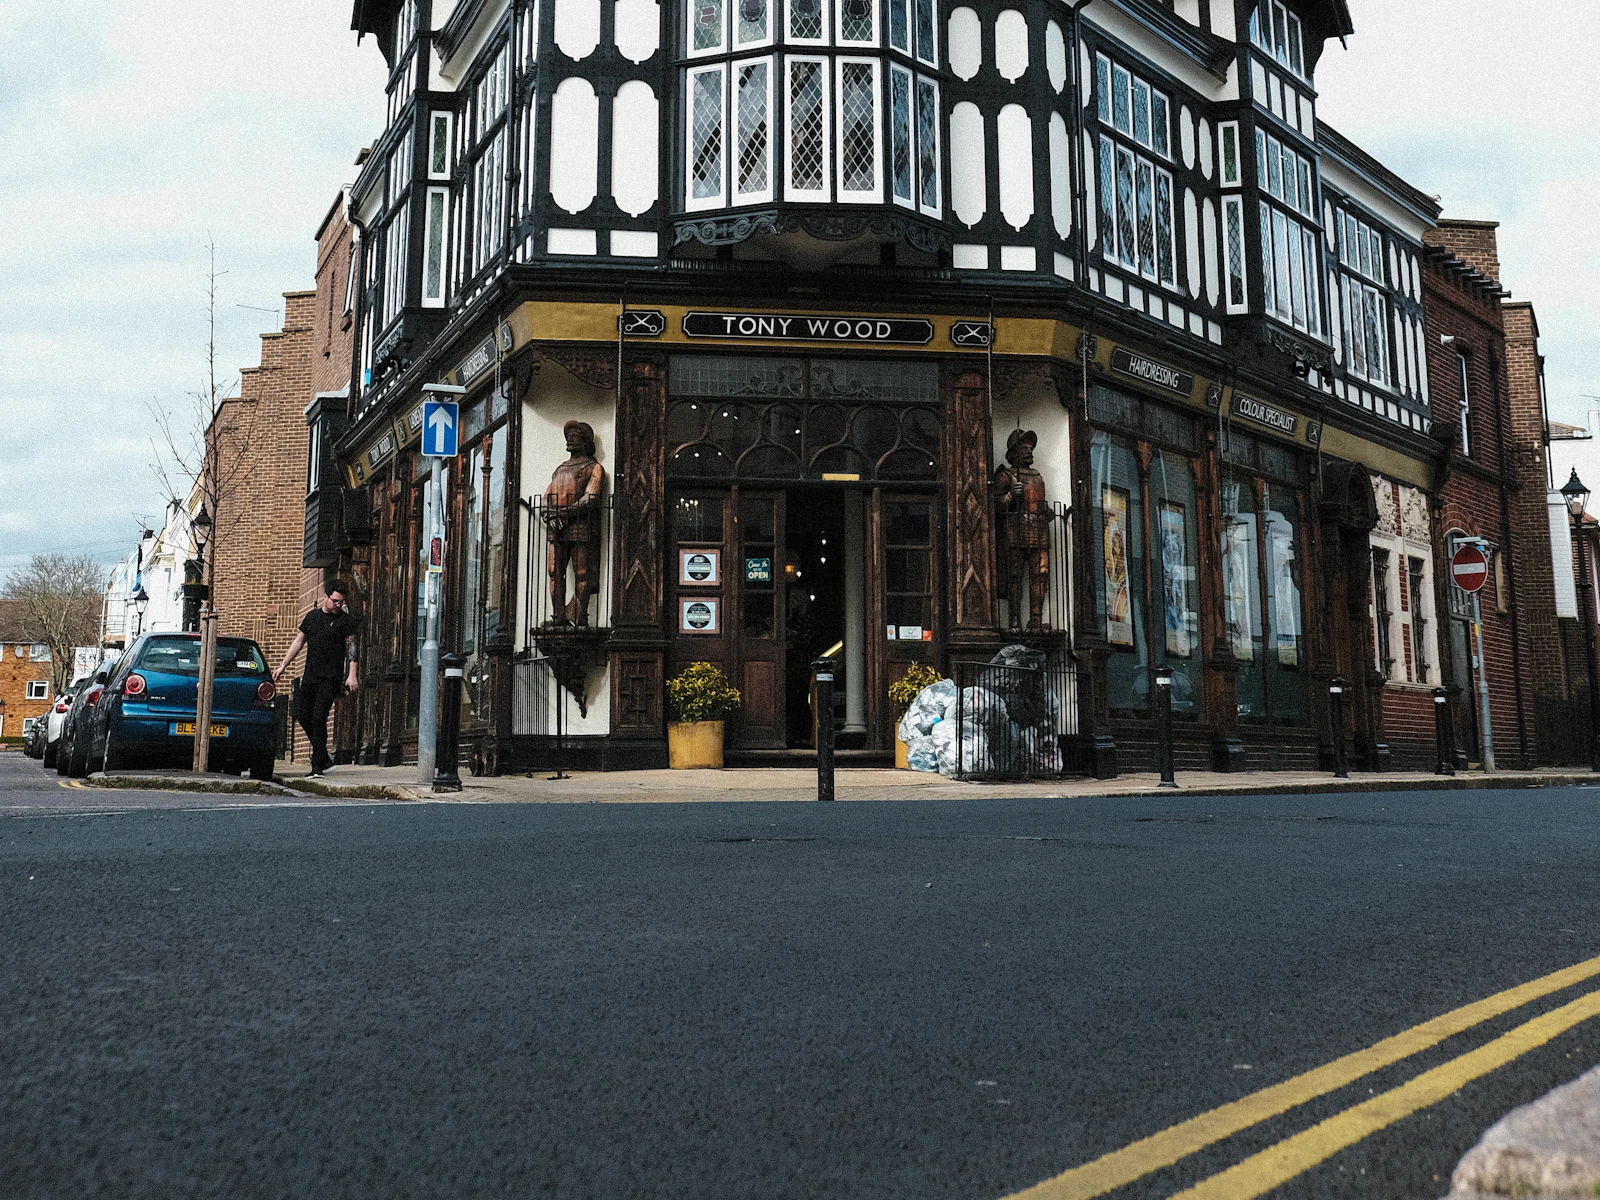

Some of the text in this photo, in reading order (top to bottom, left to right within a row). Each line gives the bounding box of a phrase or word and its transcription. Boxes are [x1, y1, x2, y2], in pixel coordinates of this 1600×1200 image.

[722, 316, 892, 339] TONY WOOD
[1128, 356, 1180, 388] HAIRDRESSING
[1240, 399, 1295, 431] COLOUR SPECIALIST
[747, 571, 769, 579] OPEN
[177, 723, 198, 734] BL5
